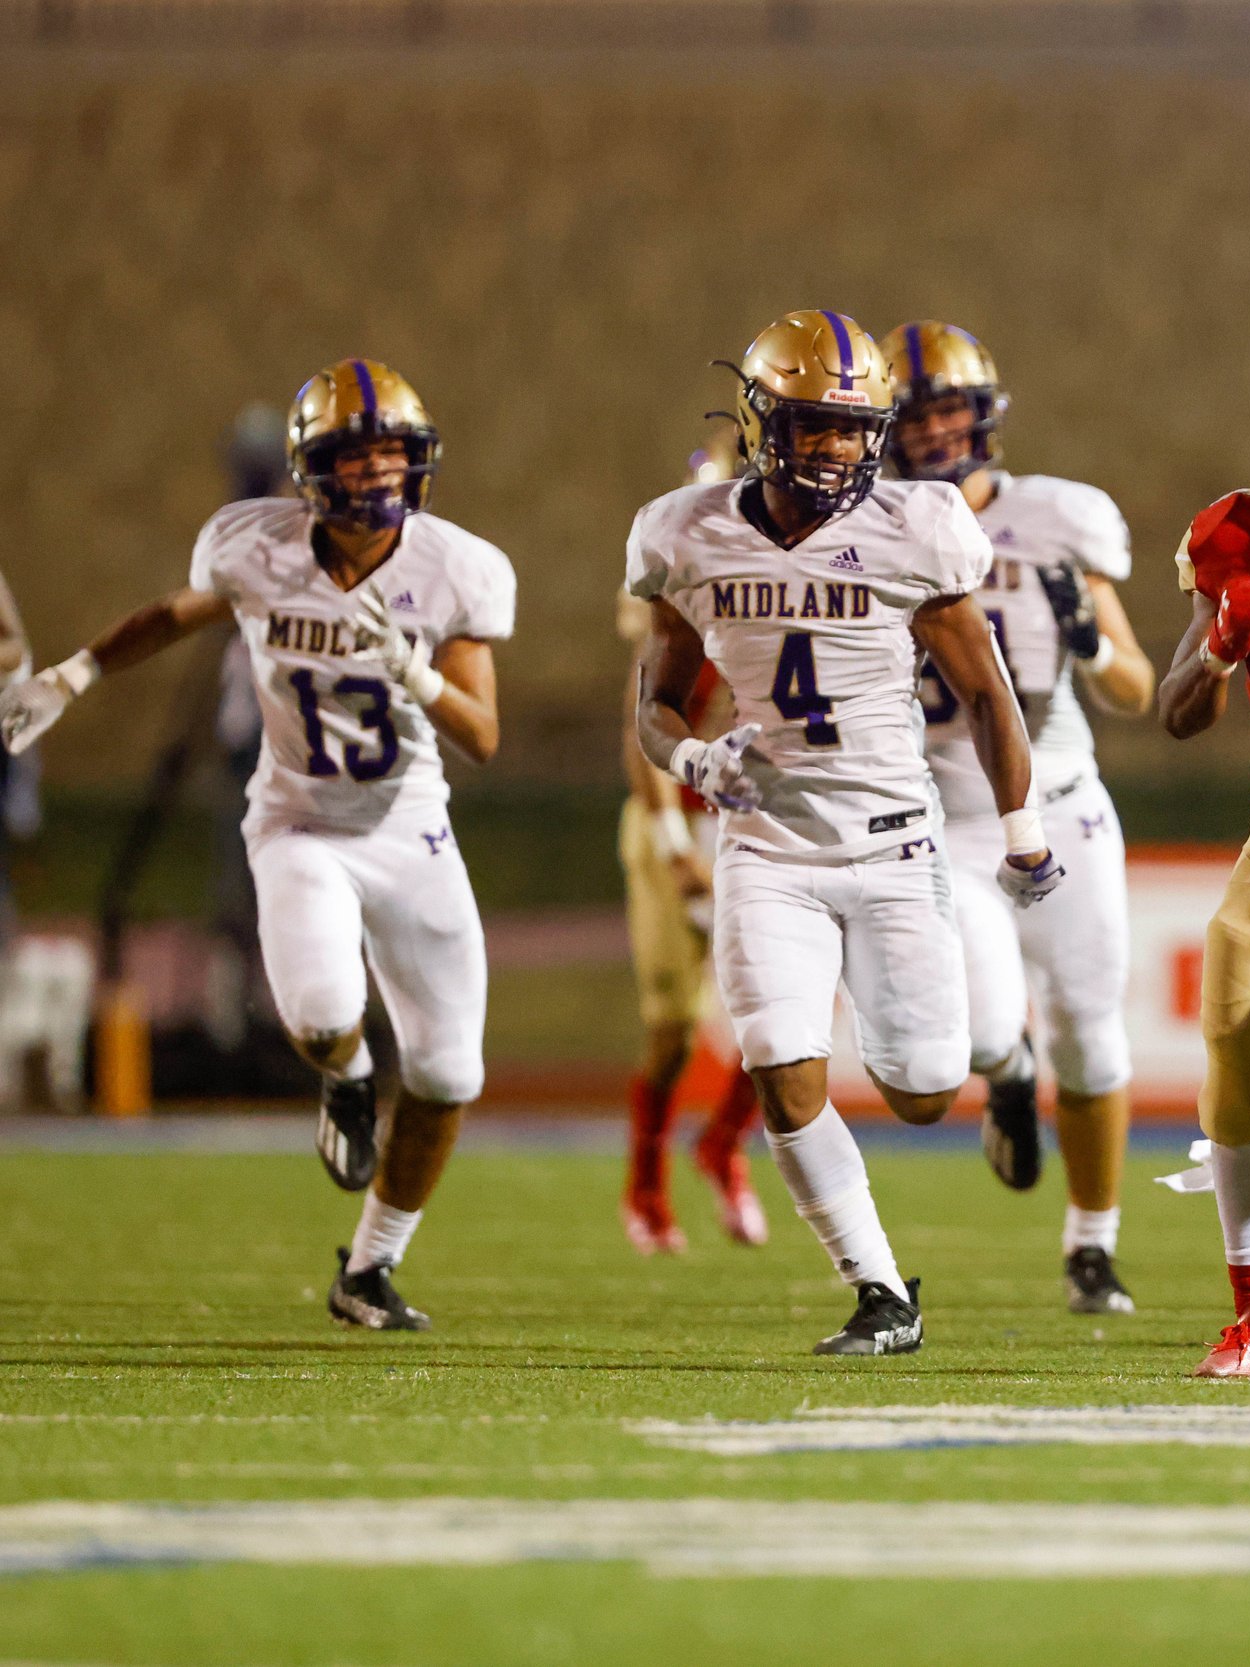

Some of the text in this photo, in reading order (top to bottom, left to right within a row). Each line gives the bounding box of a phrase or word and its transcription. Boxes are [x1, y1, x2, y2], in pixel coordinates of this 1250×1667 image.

[829, 392, 865, 402] Riddell
[829, 559, 863, 572] adidas
[711, 581, 872, 620] MIDLAND
[266, 610, 418, 656] MIDL
[771, 632, 842, 746] 4
[288, 667, 399, 783] 13
